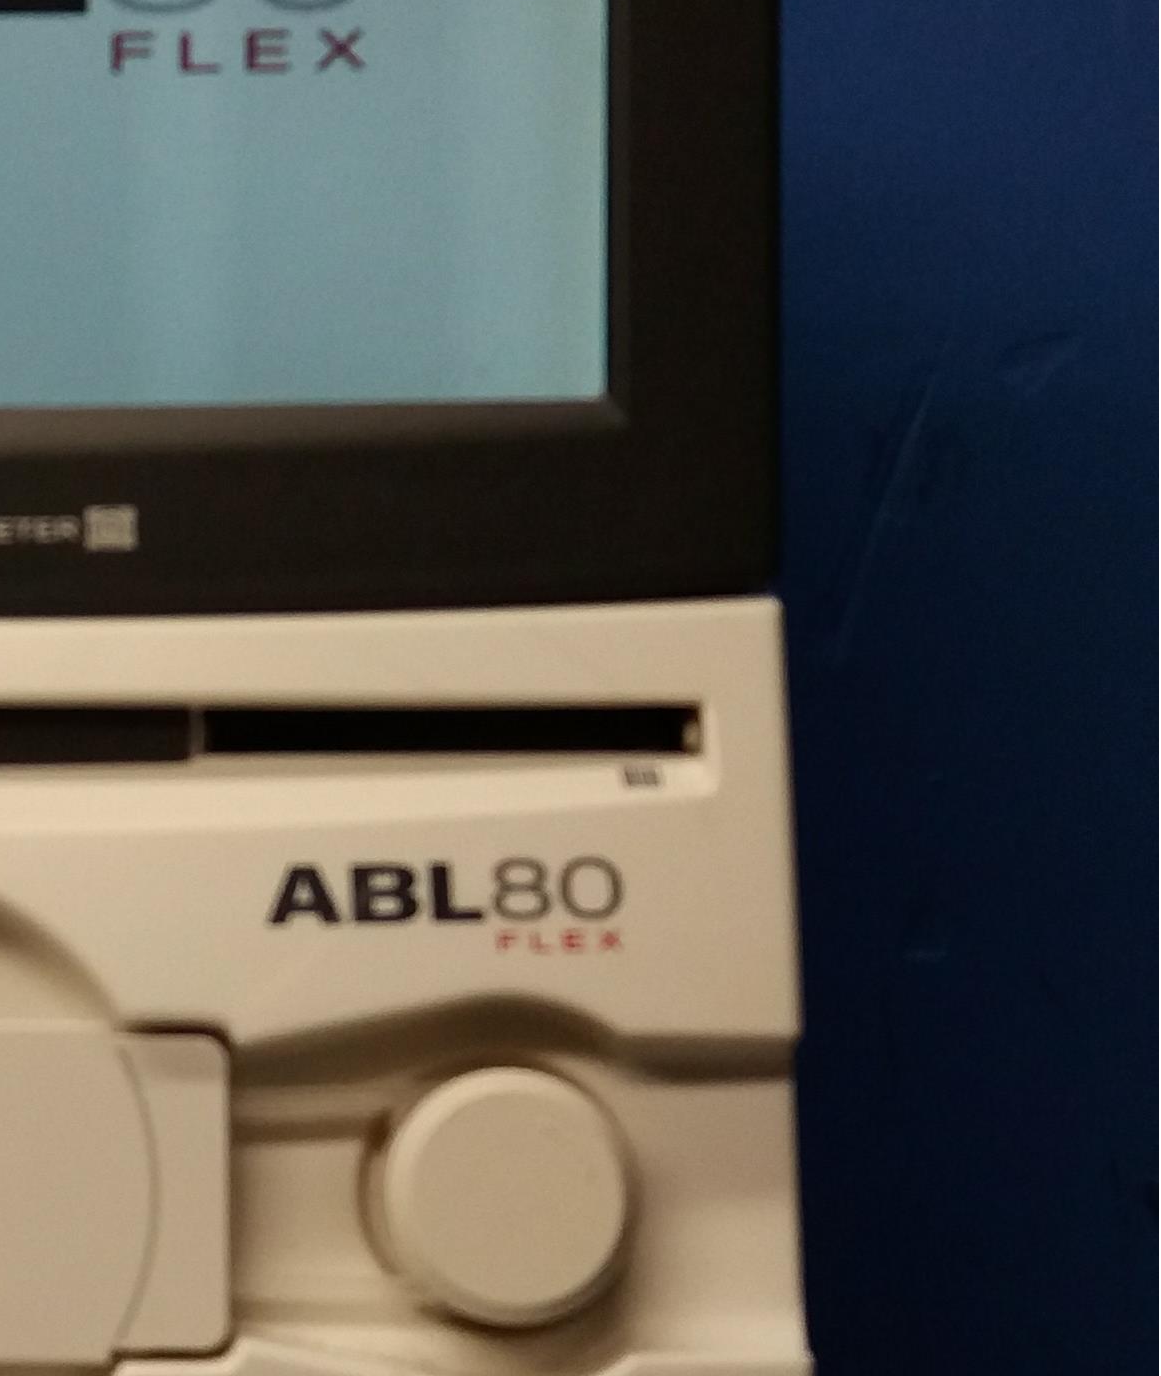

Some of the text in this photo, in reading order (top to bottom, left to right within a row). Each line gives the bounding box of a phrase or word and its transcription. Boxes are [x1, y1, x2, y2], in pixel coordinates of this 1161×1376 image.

[110, 30, 366, 74] FLEX
[269, 856, 624, 926] ABL80
[495, 930, 623, 953] FLEX
